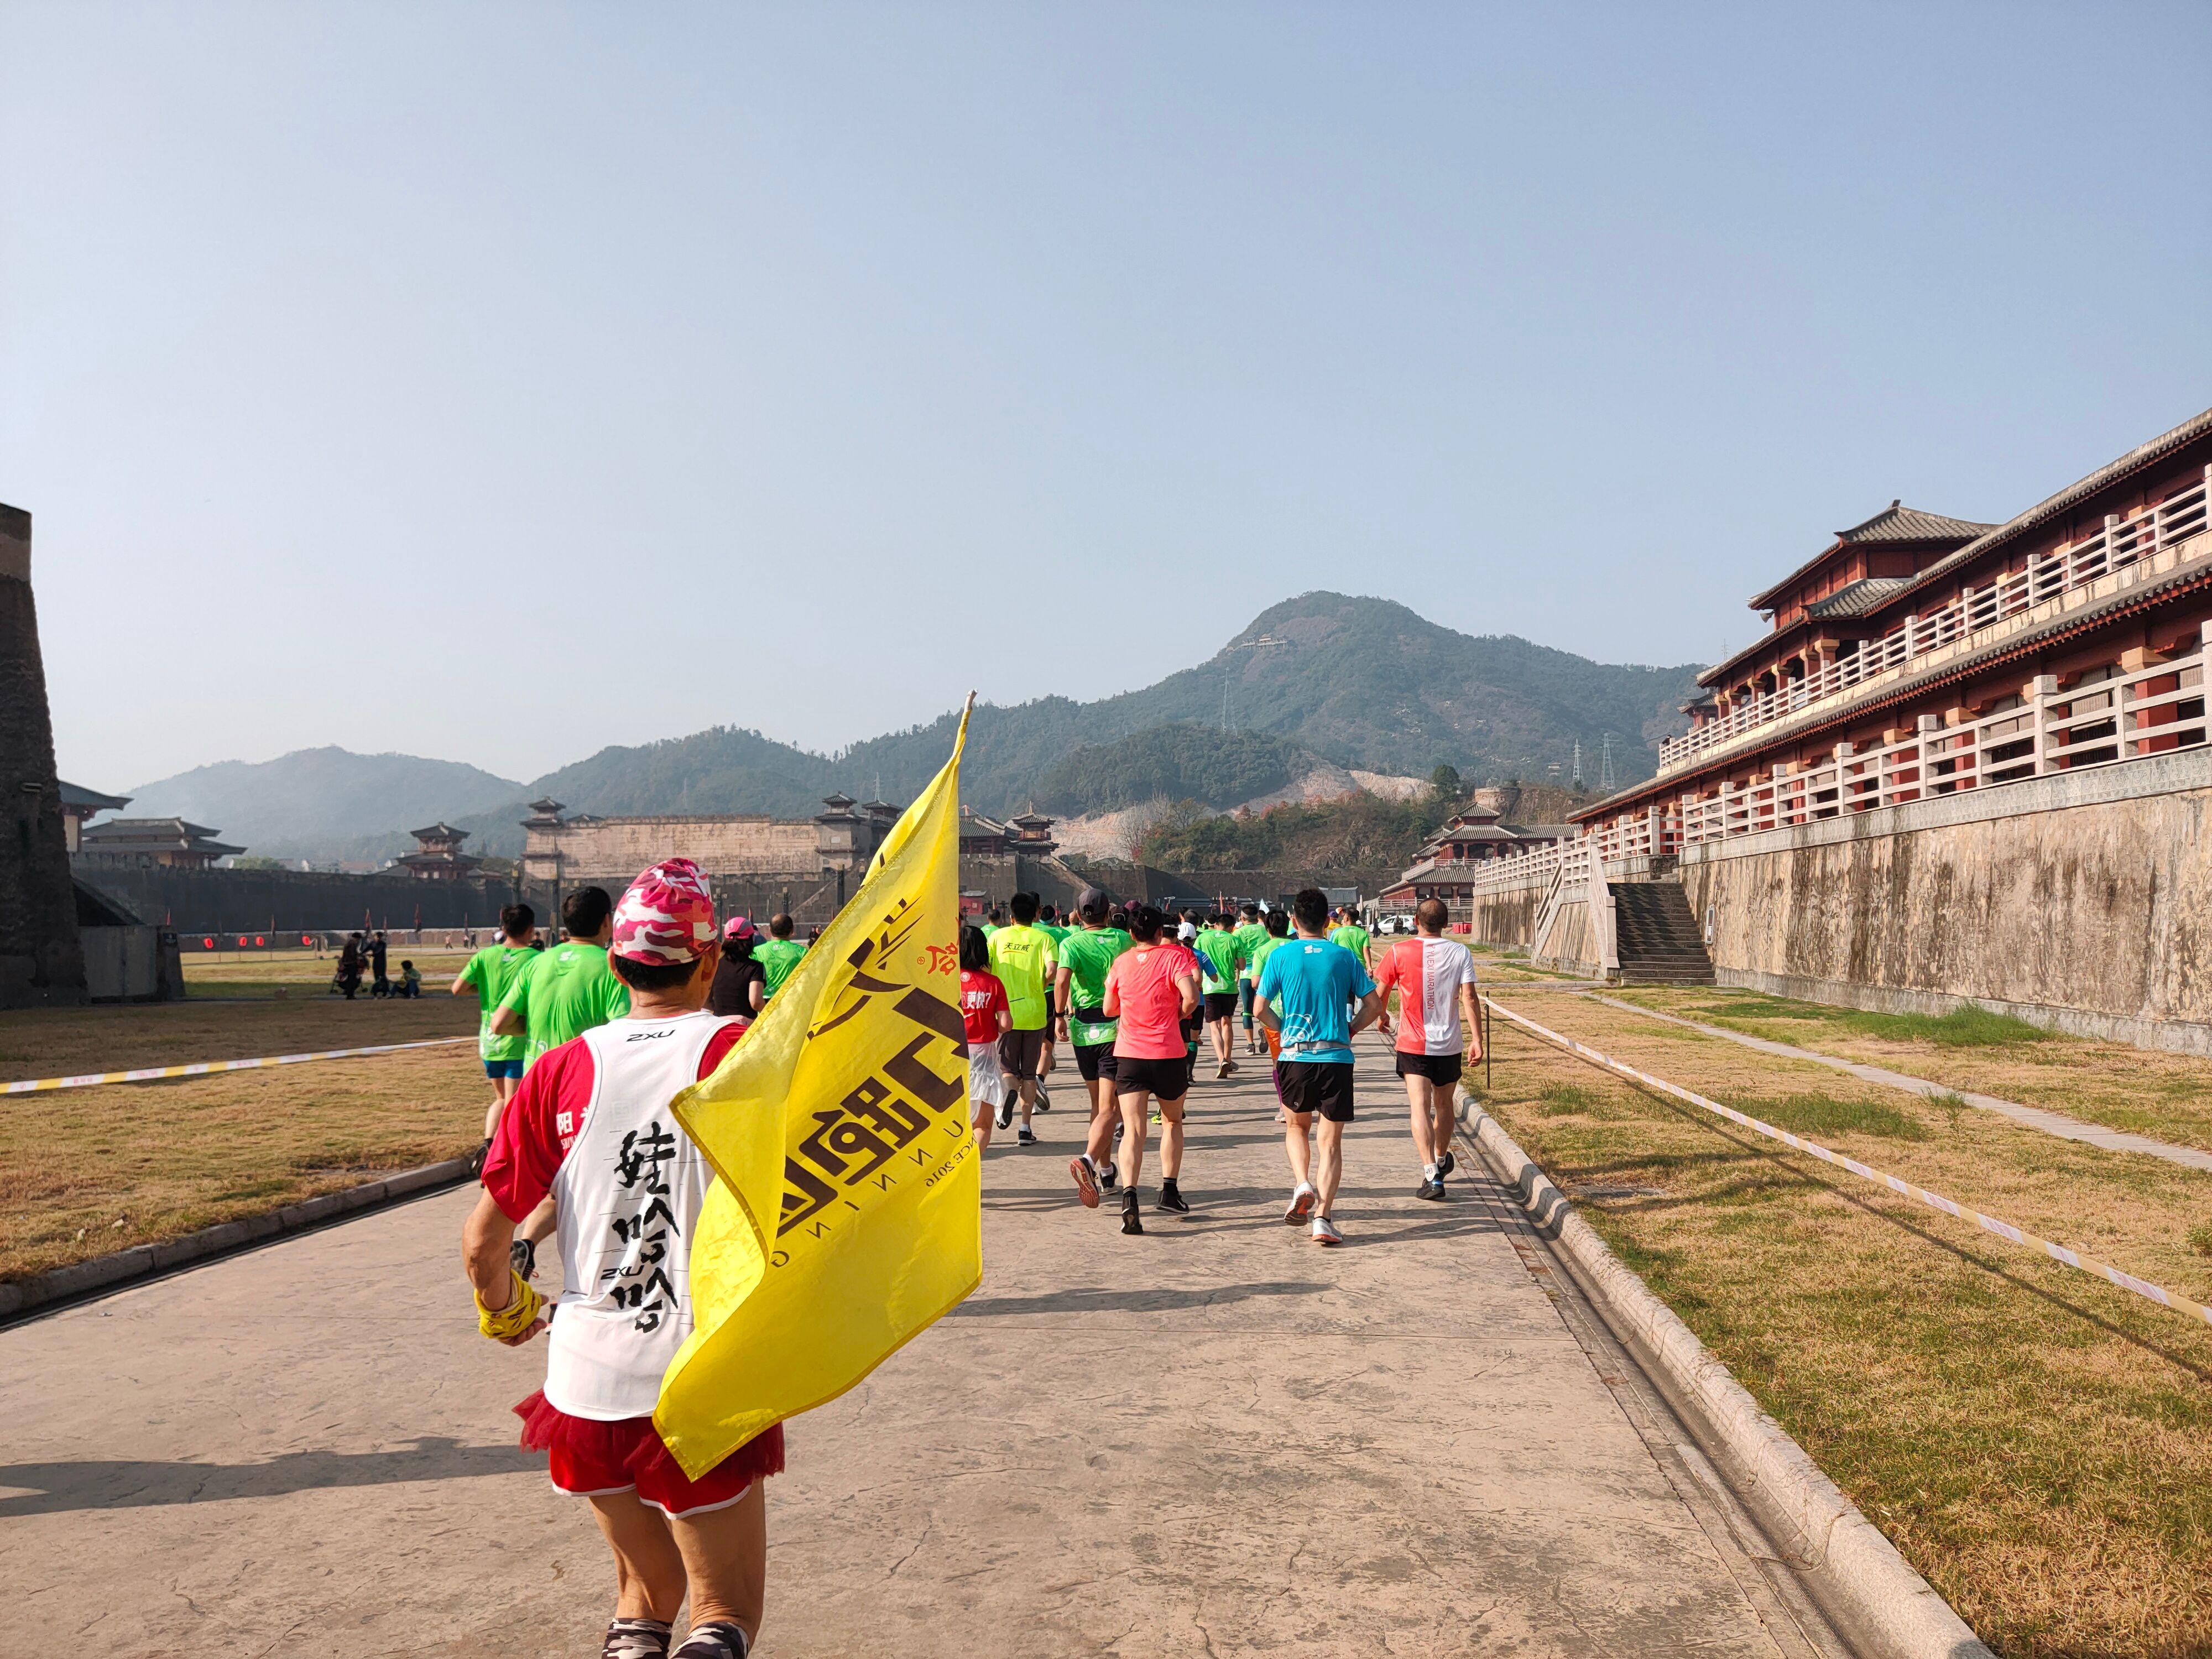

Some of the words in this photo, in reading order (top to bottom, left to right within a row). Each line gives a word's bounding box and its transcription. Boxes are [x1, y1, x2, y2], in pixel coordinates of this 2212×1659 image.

[1004, 942, 1031, 952] 天立威
[1426, 951, 1434, 970] YUEXI
[626, 1030, 675, 1042] 2XU
[556, 1107, 588, 1136] 阳
[611, 1121, 681, 1333] 娃哈哈
[601, 1265, 644, 1280] 2XU
